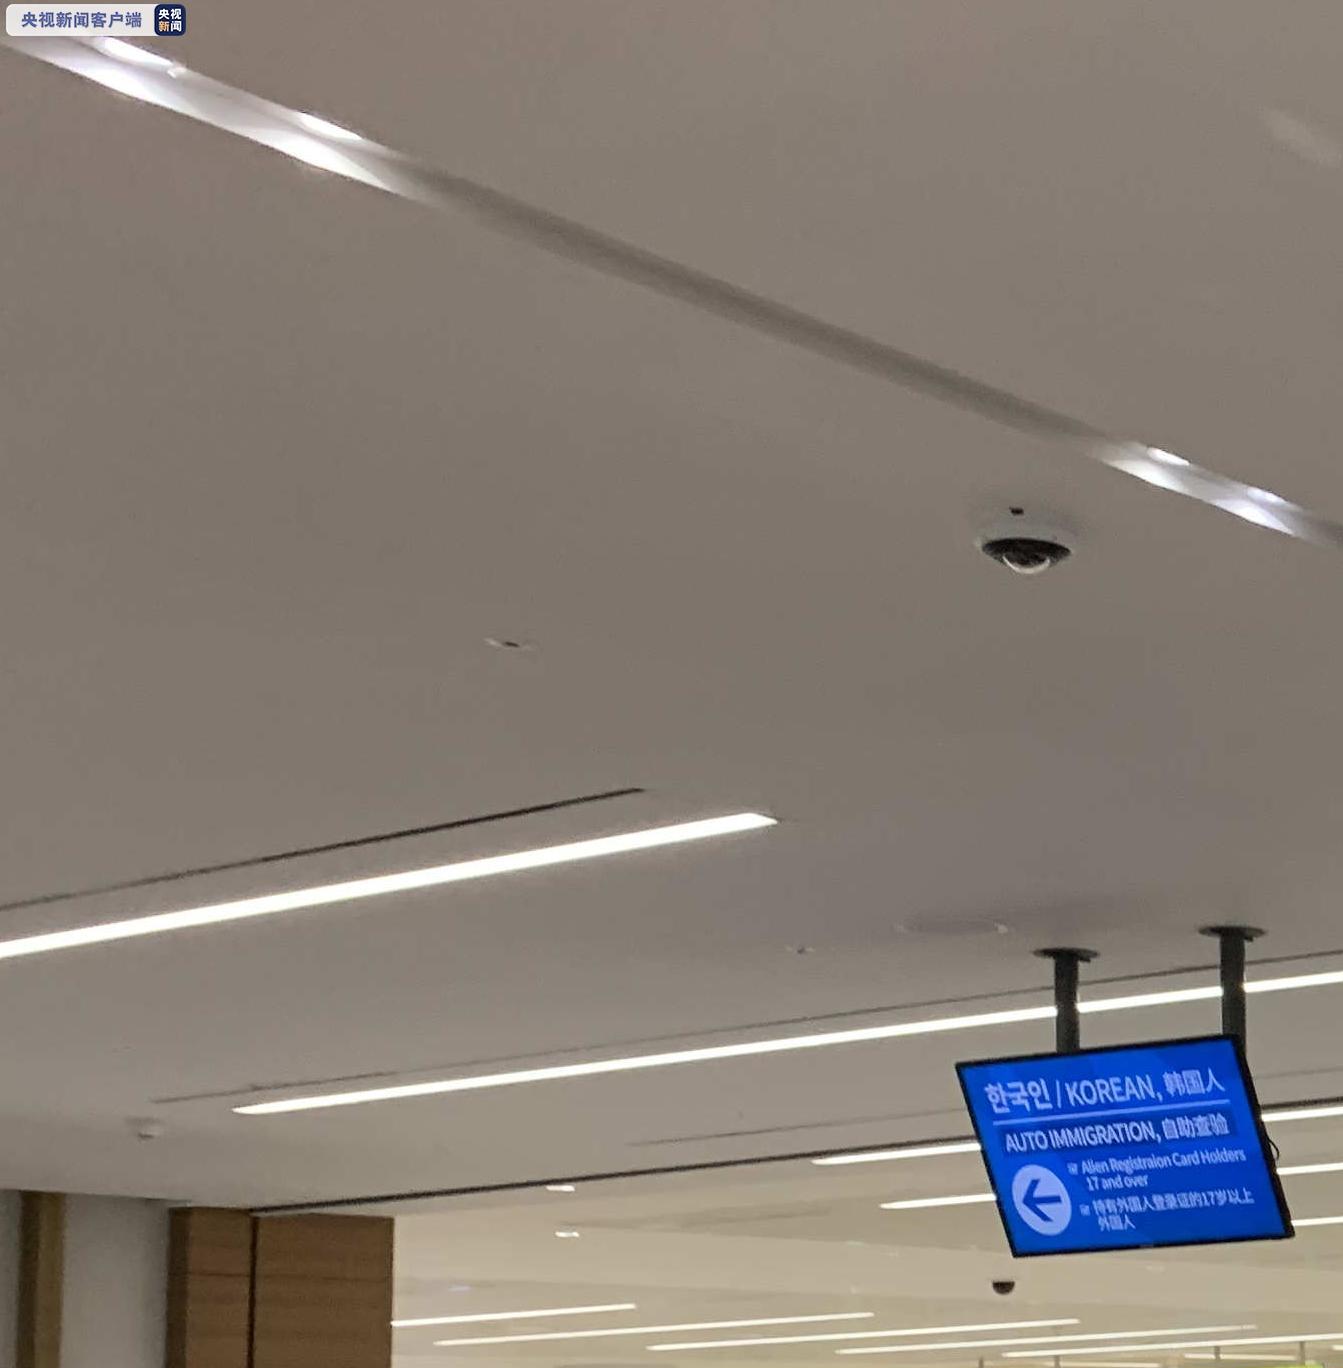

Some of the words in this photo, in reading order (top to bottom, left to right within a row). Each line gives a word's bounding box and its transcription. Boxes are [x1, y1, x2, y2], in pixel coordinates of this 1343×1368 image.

[984, 1078, 1053, 1114] 한국인
[1065, 1074, 1164, 1108] KOREAN,
[1005, 1131, 1049, 1152] AUTO
[1050, 1121, 1161, 1148] IMMIGRATION,
[1081, 1159, 1110, 1175] Alien
[1173, 1151, 1201, 1167] Card
[1200, 1147, 1247, 1163] Holders
[1086, 1176, 1099, 1191] 17
[1102, 1174, 1123, 1190] and
[1124, 1174, 1149, 1188] over
